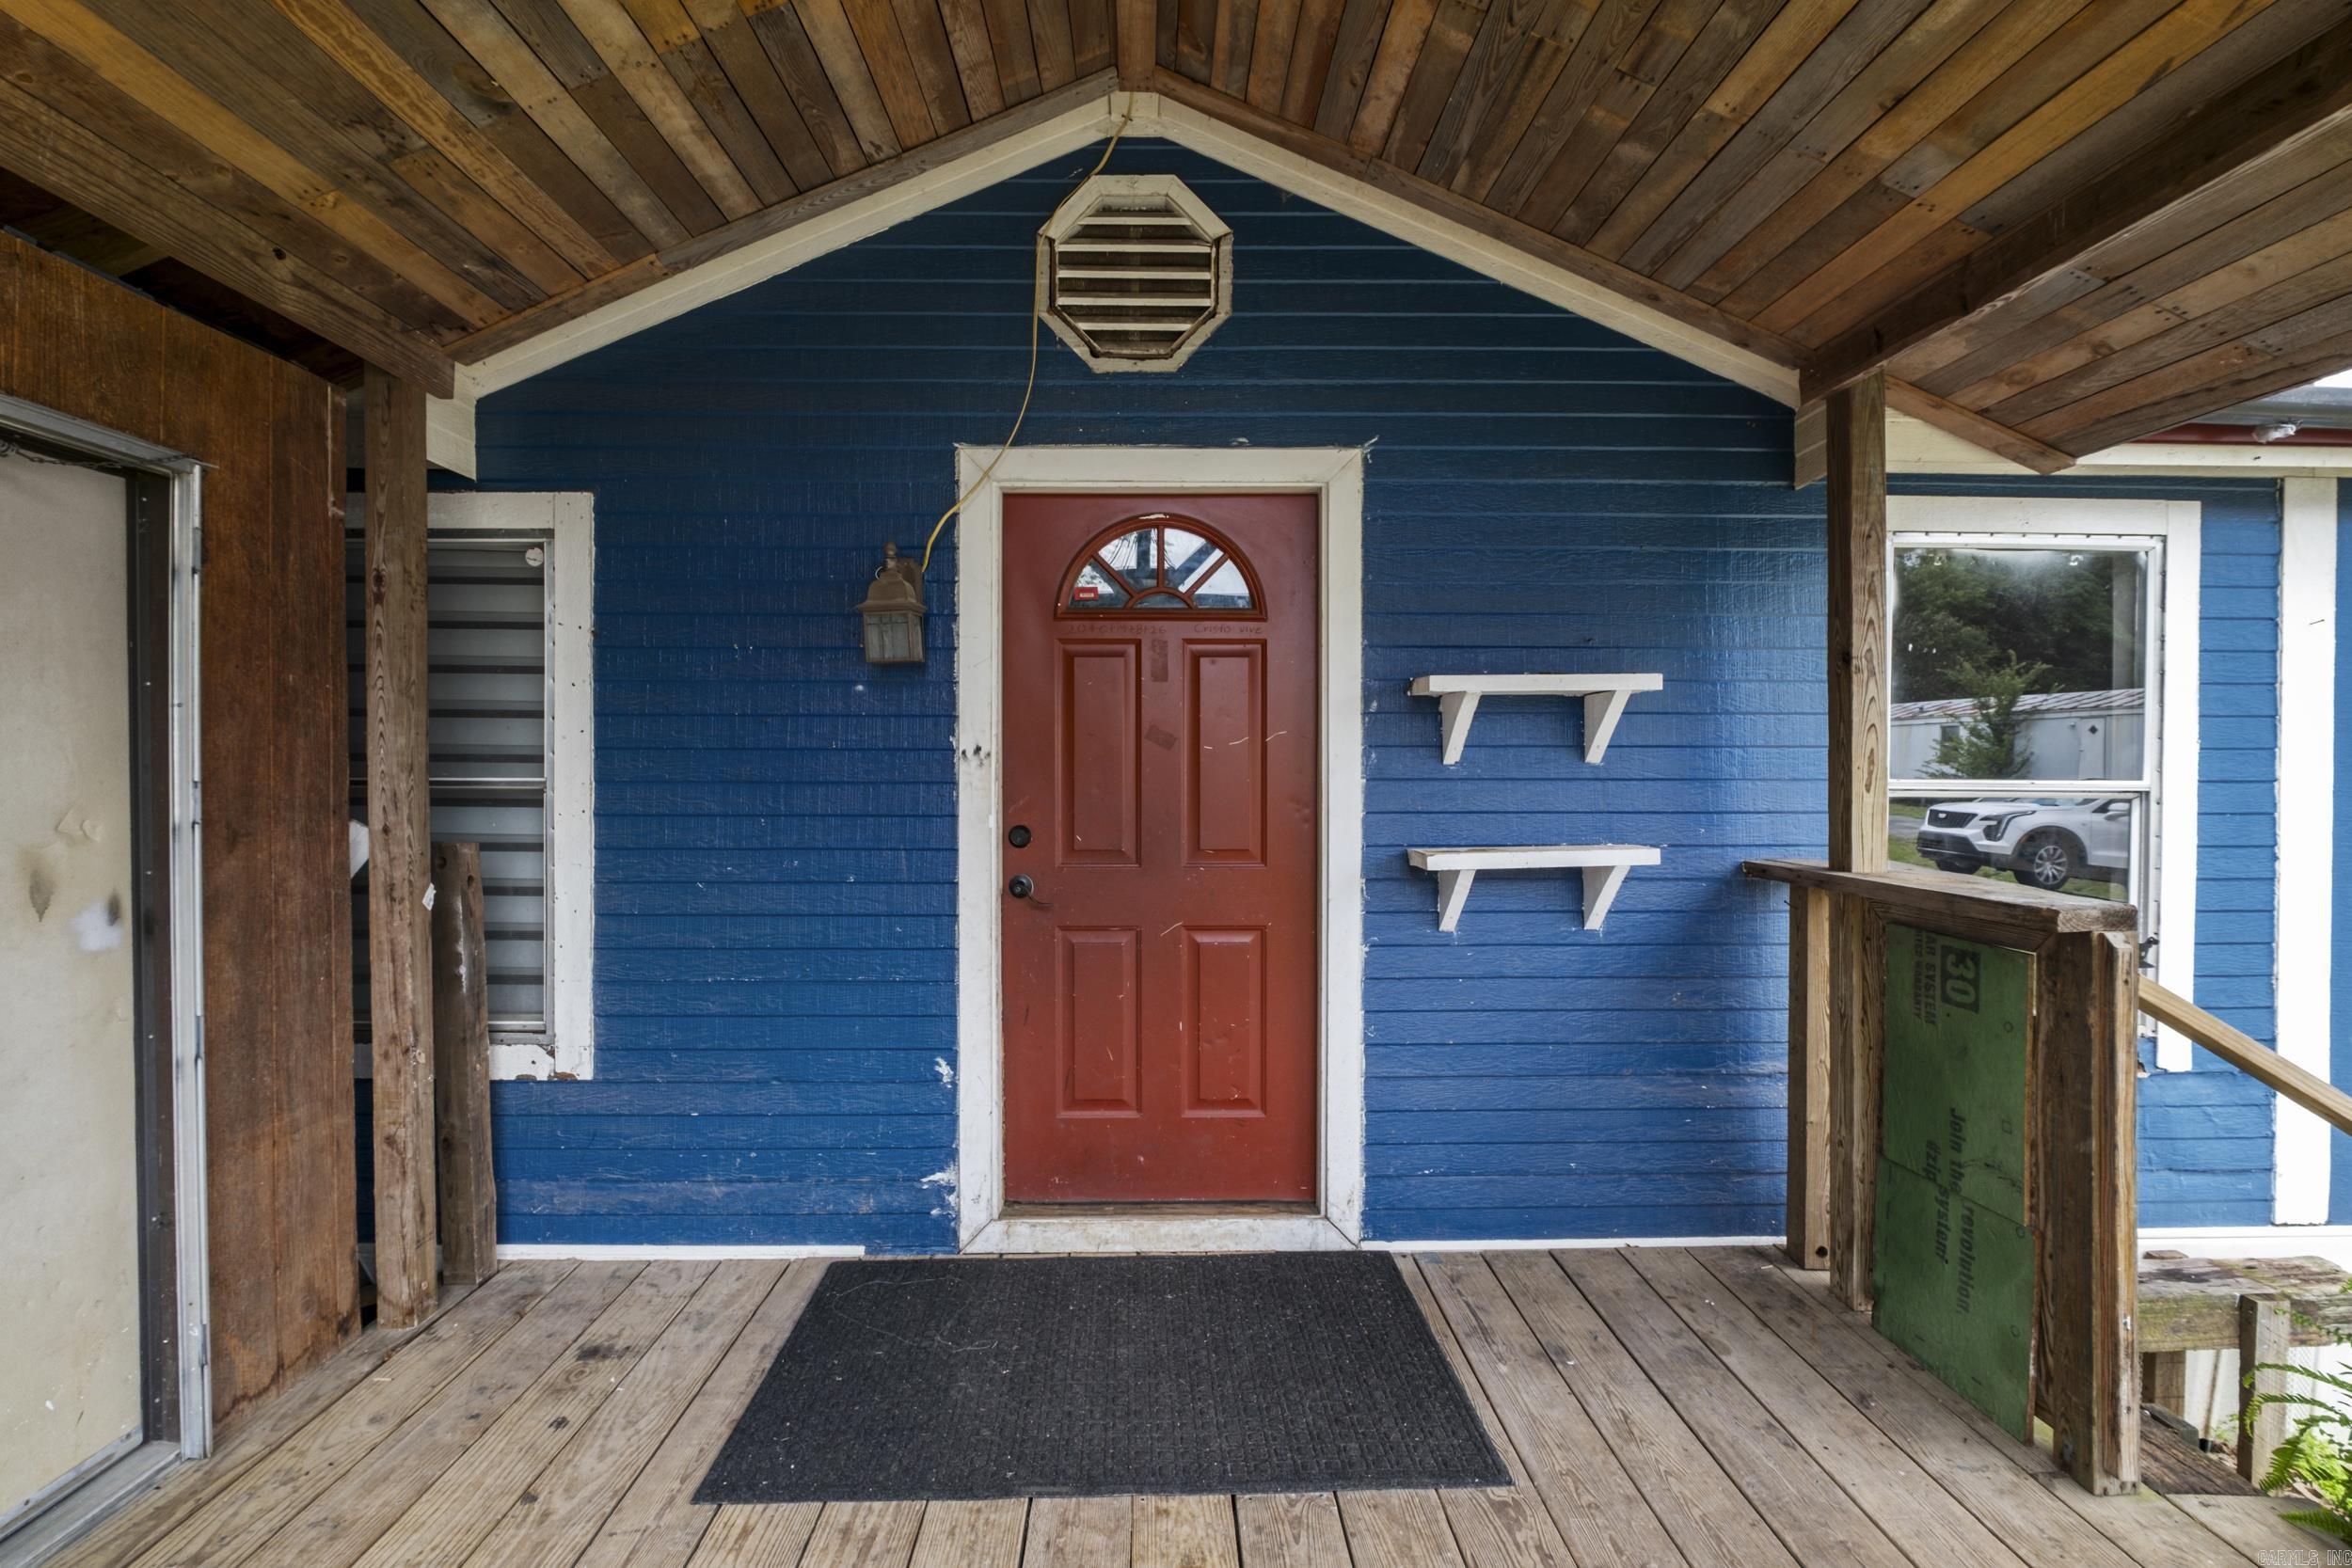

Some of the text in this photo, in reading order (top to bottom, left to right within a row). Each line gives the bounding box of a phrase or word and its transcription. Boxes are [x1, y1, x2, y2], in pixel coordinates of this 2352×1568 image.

[1193, 624, 1232, 634] Cristo
[1925, 962, 1937, 1025] SYSTEM
[1945, 953, 1977, 1006] 30
[1948, 1108, 1966, 1154] Join
[1922, 1139, 1951, 1260] #zip system
[1948, 1159, 1965, 1196] the
